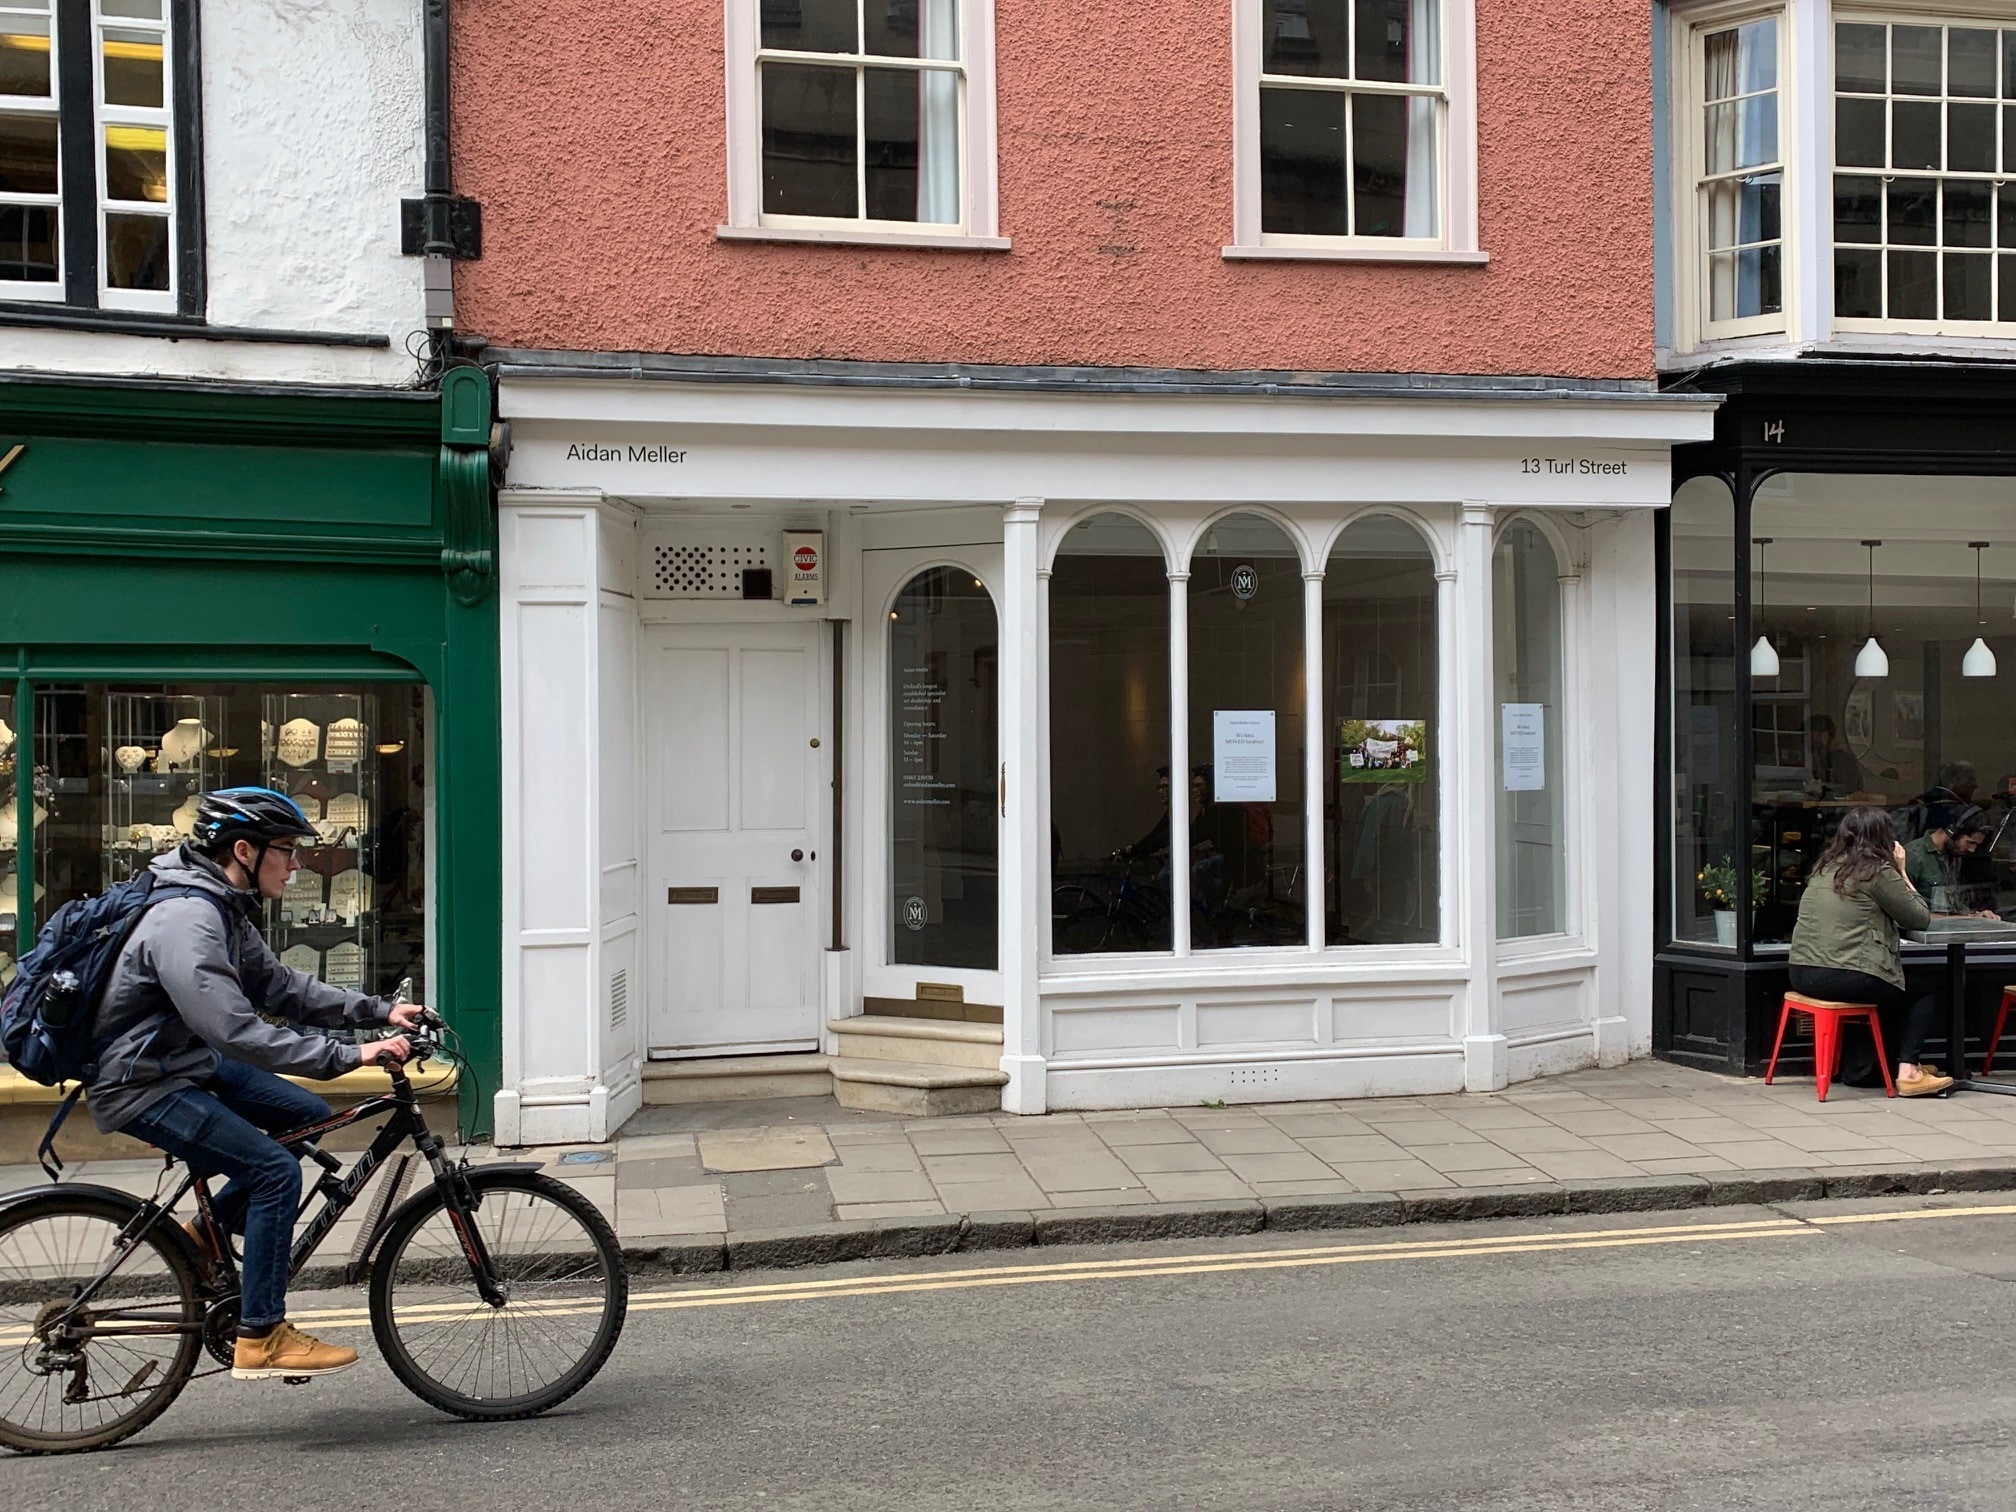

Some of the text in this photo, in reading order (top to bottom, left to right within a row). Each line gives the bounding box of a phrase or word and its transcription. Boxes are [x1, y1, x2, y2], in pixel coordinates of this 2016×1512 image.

[1764, 419, 1785, 443] 14
[566, 443, 687, 463] Aidan Meller
[1521, 458, 1628, 475] 13 Turl Street
[793, 554, 819, 563] CIVIC
[794, 573, 819, 581] ALARMS
